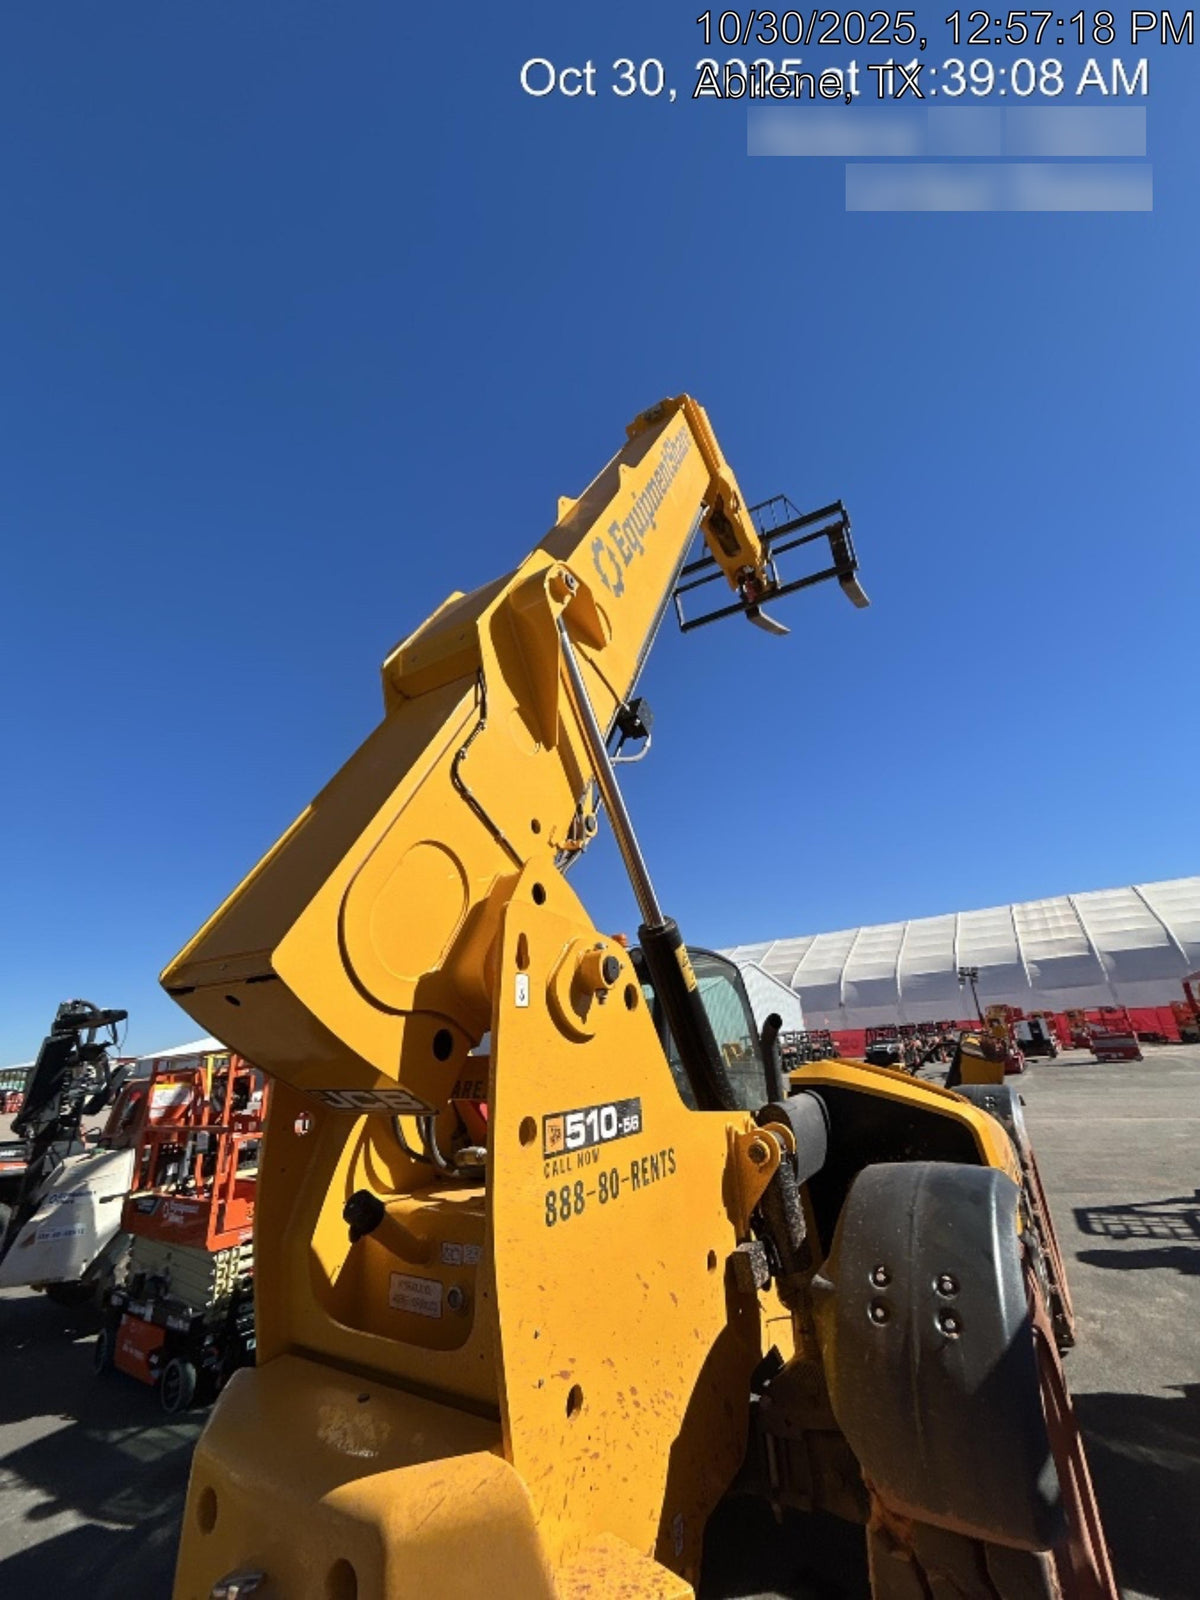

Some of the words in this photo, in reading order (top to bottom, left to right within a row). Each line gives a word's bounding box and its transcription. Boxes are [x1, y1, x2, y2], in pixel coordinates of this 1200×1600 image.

[319, 1090, 427, 1111] JCB
[544, 1156, 572, 1179] CALL
[577, 1149, 600, 1168] NOW
[545, 1148, 676, 1227] 888-80-RENTS
